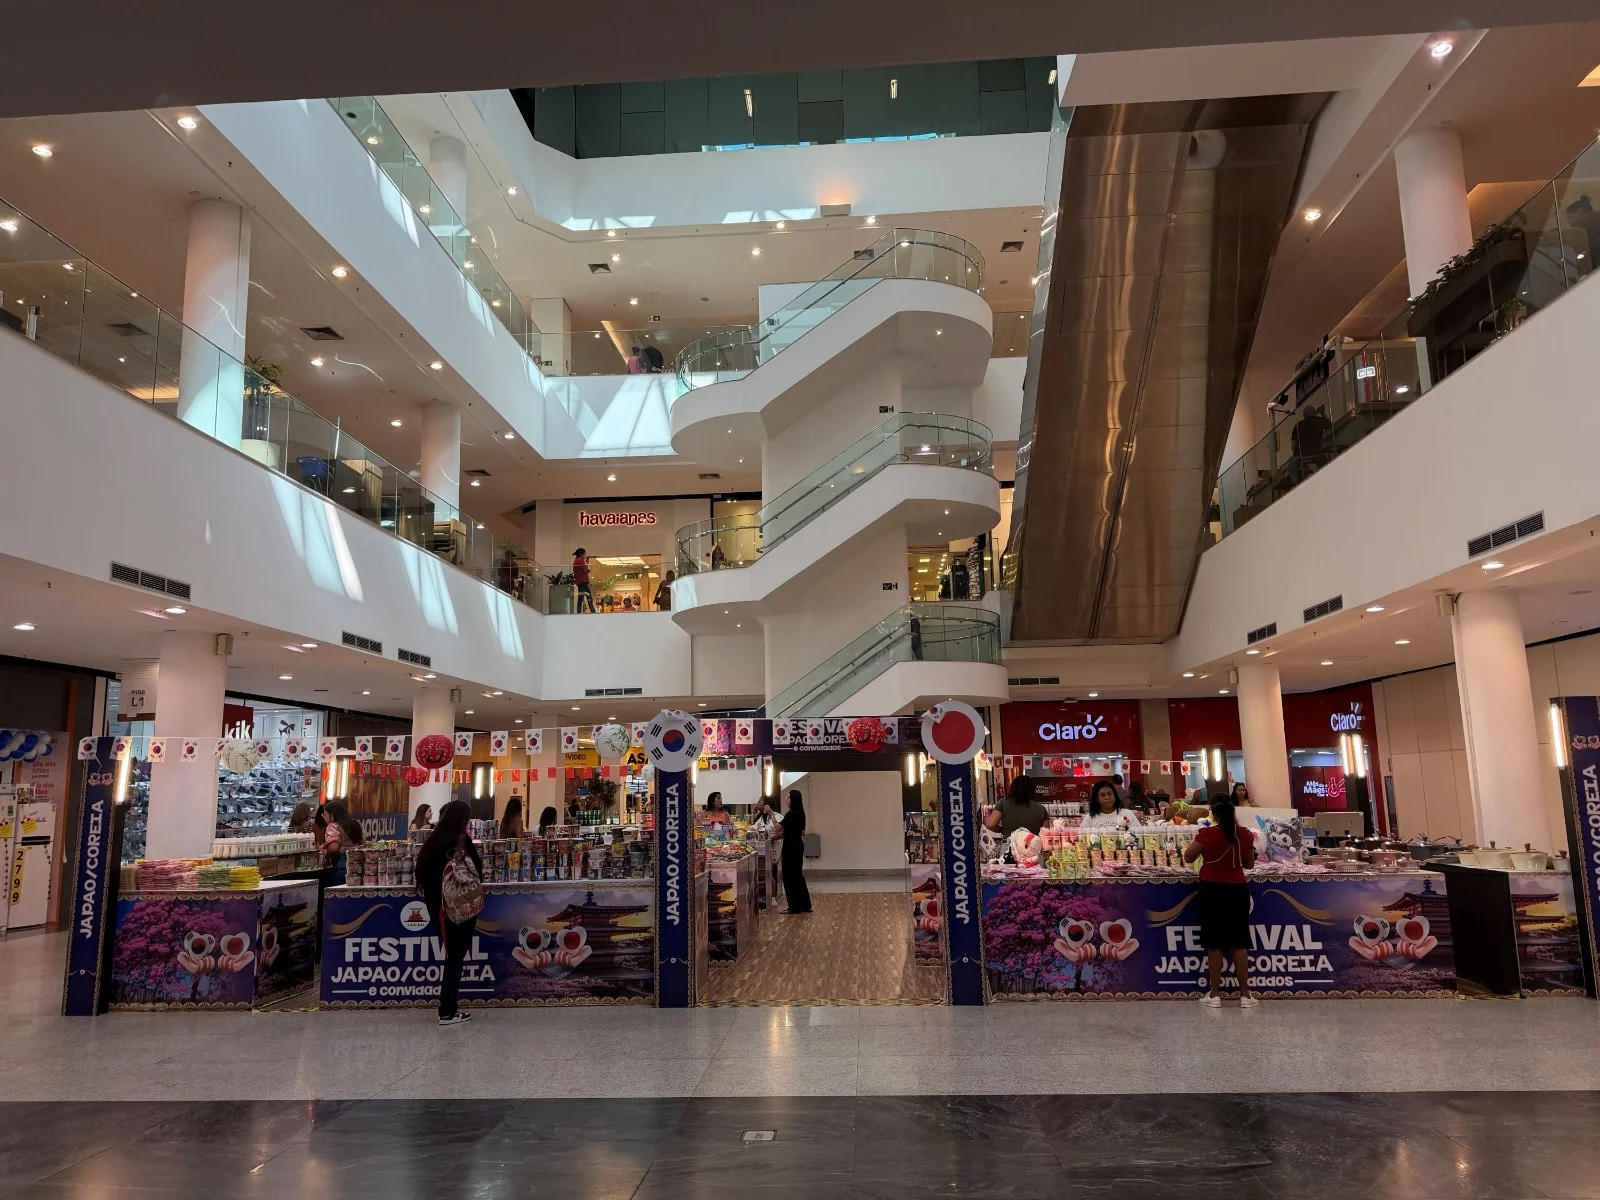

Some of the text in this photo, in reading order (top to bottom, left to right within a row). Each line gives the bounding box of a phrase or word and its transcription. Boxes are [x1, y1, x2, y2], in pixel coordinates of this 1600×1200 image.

[580, 511, 656, 526] havaianas
[131, 697, 144, 707] L1
[1038, 721, 1098, 741] Claro
[1330, 711, 1358, 732] Claro
[665, 782, 680, 926] JAPAO/COREIA
[949, 777, 971, 925] JAPAO/COREIA
[79, 799, 105, 940] JAPAO/COREIA
[1165, 924, 1323, 951] FEIVAL
[331, 964, 496, 983] JAPAO/COIA
[1197, 976, 1207, 987] e
[368, 985, 442, 996] e convidad
